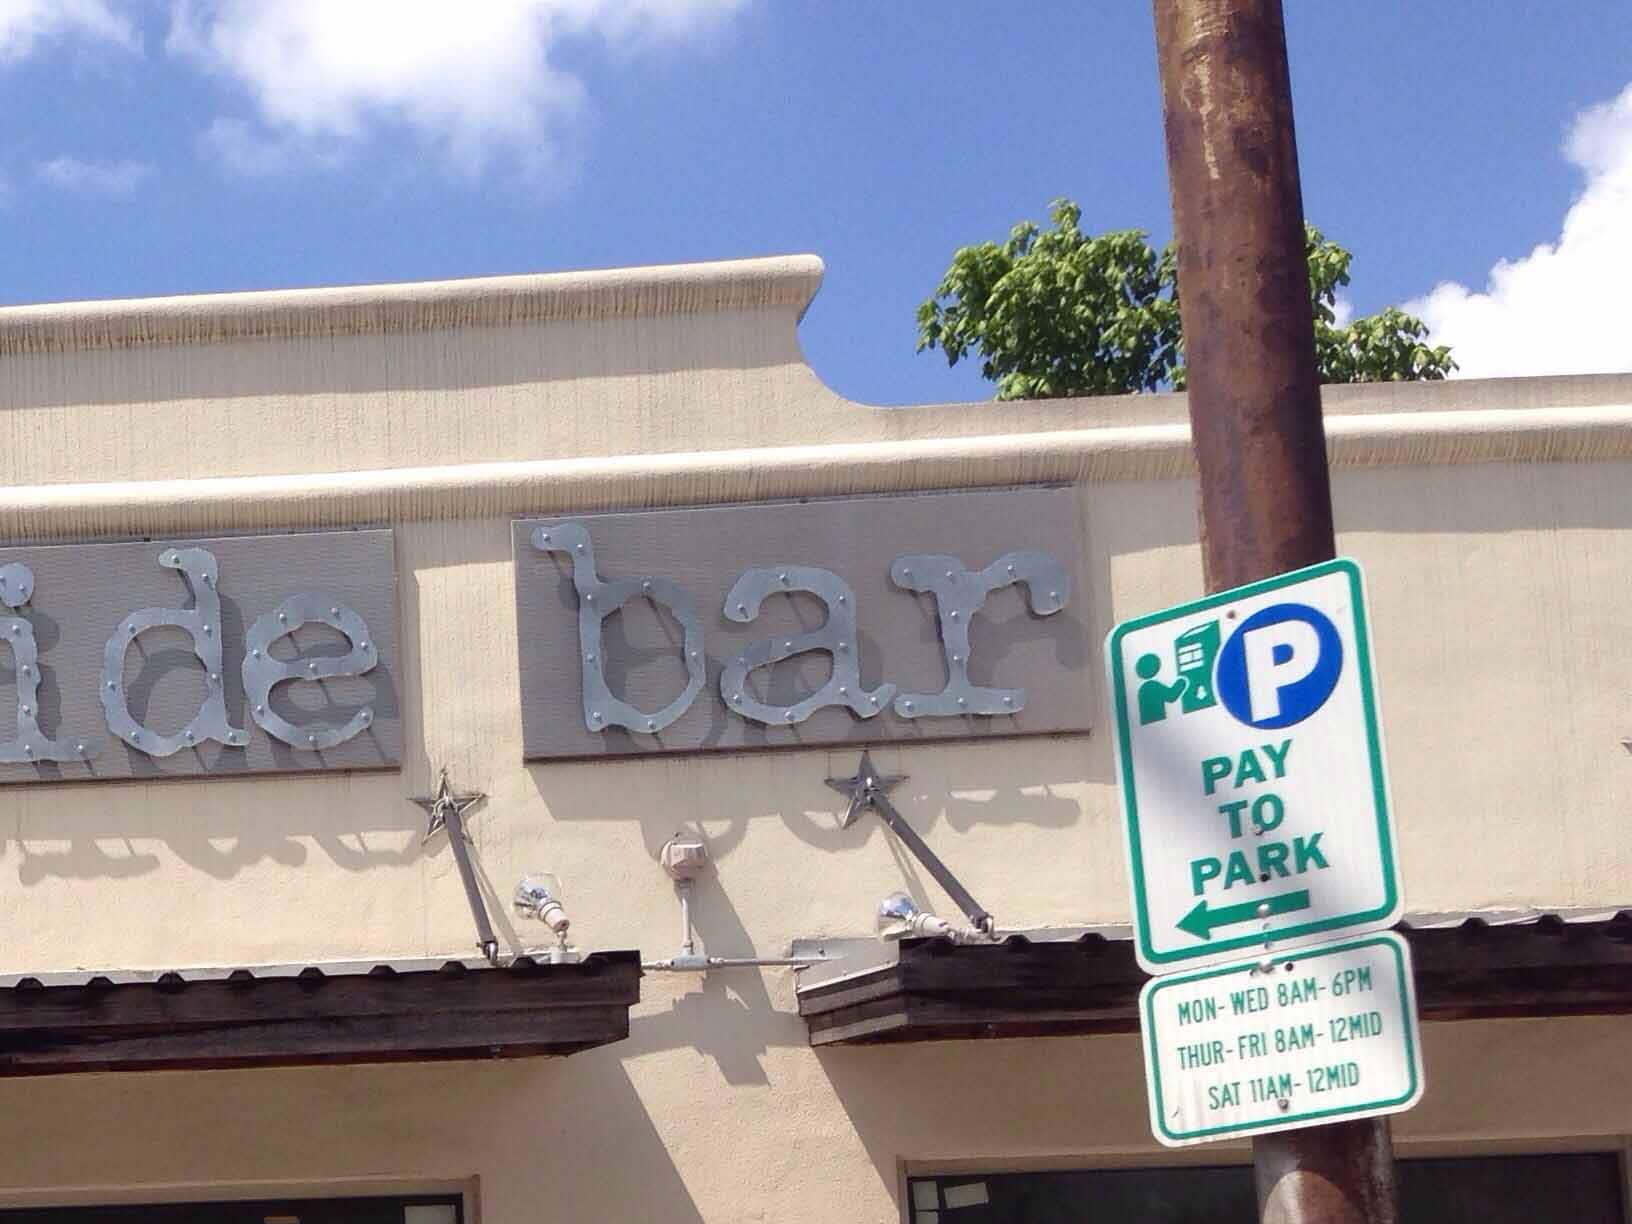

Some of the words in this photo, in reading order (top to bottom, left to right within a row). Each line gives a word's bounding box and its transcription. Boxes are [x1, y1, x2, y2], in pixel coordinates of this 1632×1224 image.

[530, 521, 1069, 734] bar
[1242, 619, 1320, 723] P
[1201, 738, 1293, 796] PAY
[1218, 793, 1285, 839] TO
[1190, 831, 1330, 897] PARK
[1208, 1081, 1241, 1110] SAT
